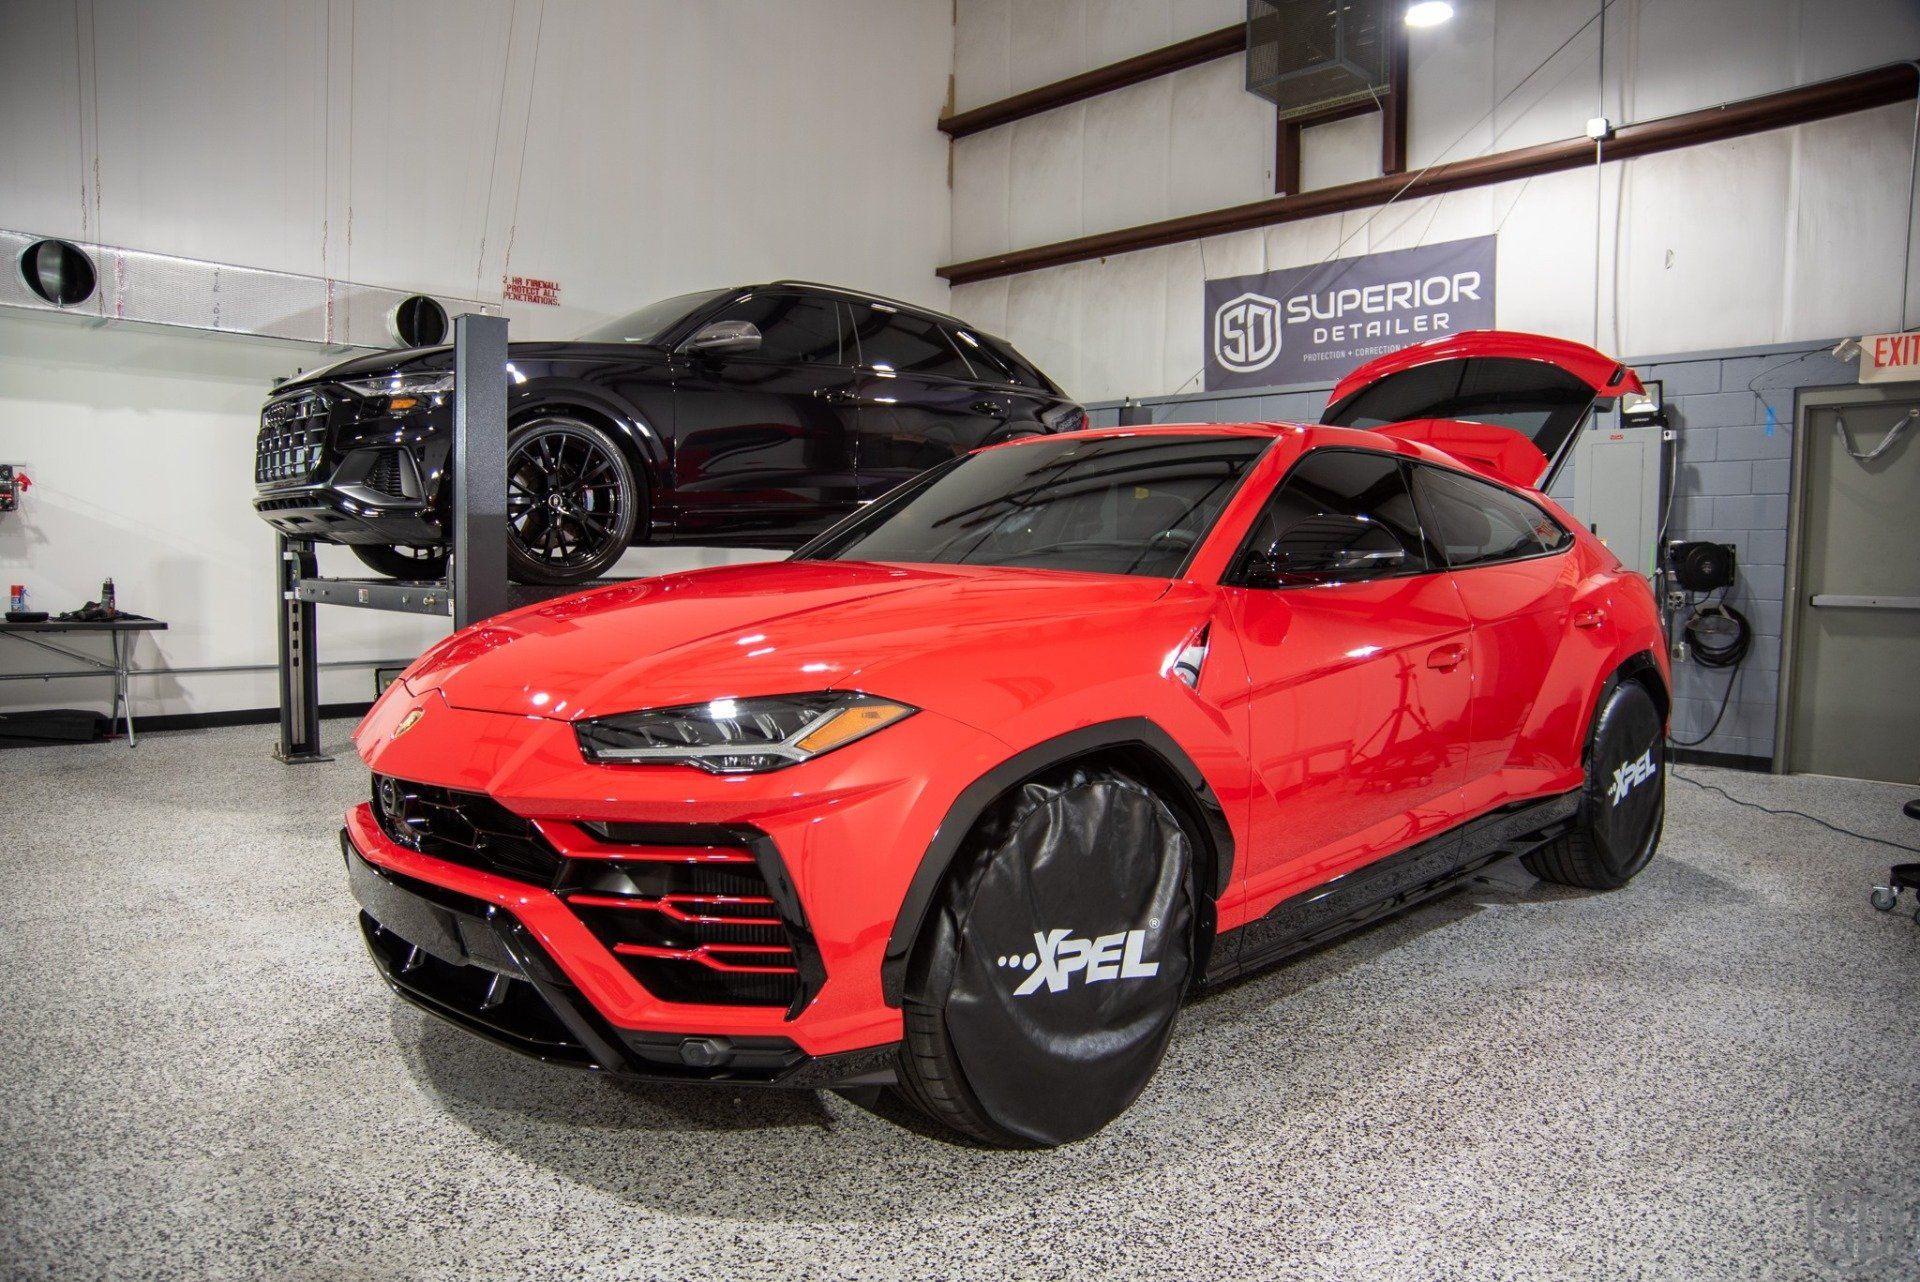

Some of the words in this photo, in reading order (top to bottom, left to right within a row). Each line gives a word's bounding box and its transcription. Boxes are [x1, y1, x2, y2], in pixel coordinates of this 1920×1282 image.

[502, 275, 508, 284] 2
[511, 276, 522, 286] HR
[525, 278, 561, 291] FIREWALL
[506, 284, 540, 296] PROTECT
[543, 288, 558, 298] ALL
[1287, 271, 1482, 324] SUPERIOR
[1223, 303, 1273, 363] SD
[1314, 312, 1451, 344] DETAILER
[1303, 350, 1346, 362] PROTECTION
[1355, 344, 1401, 357] CORRECTION
[1874, 334, 1920, 368] EXIT
[1612, 748, 1656, 807] XPEL
